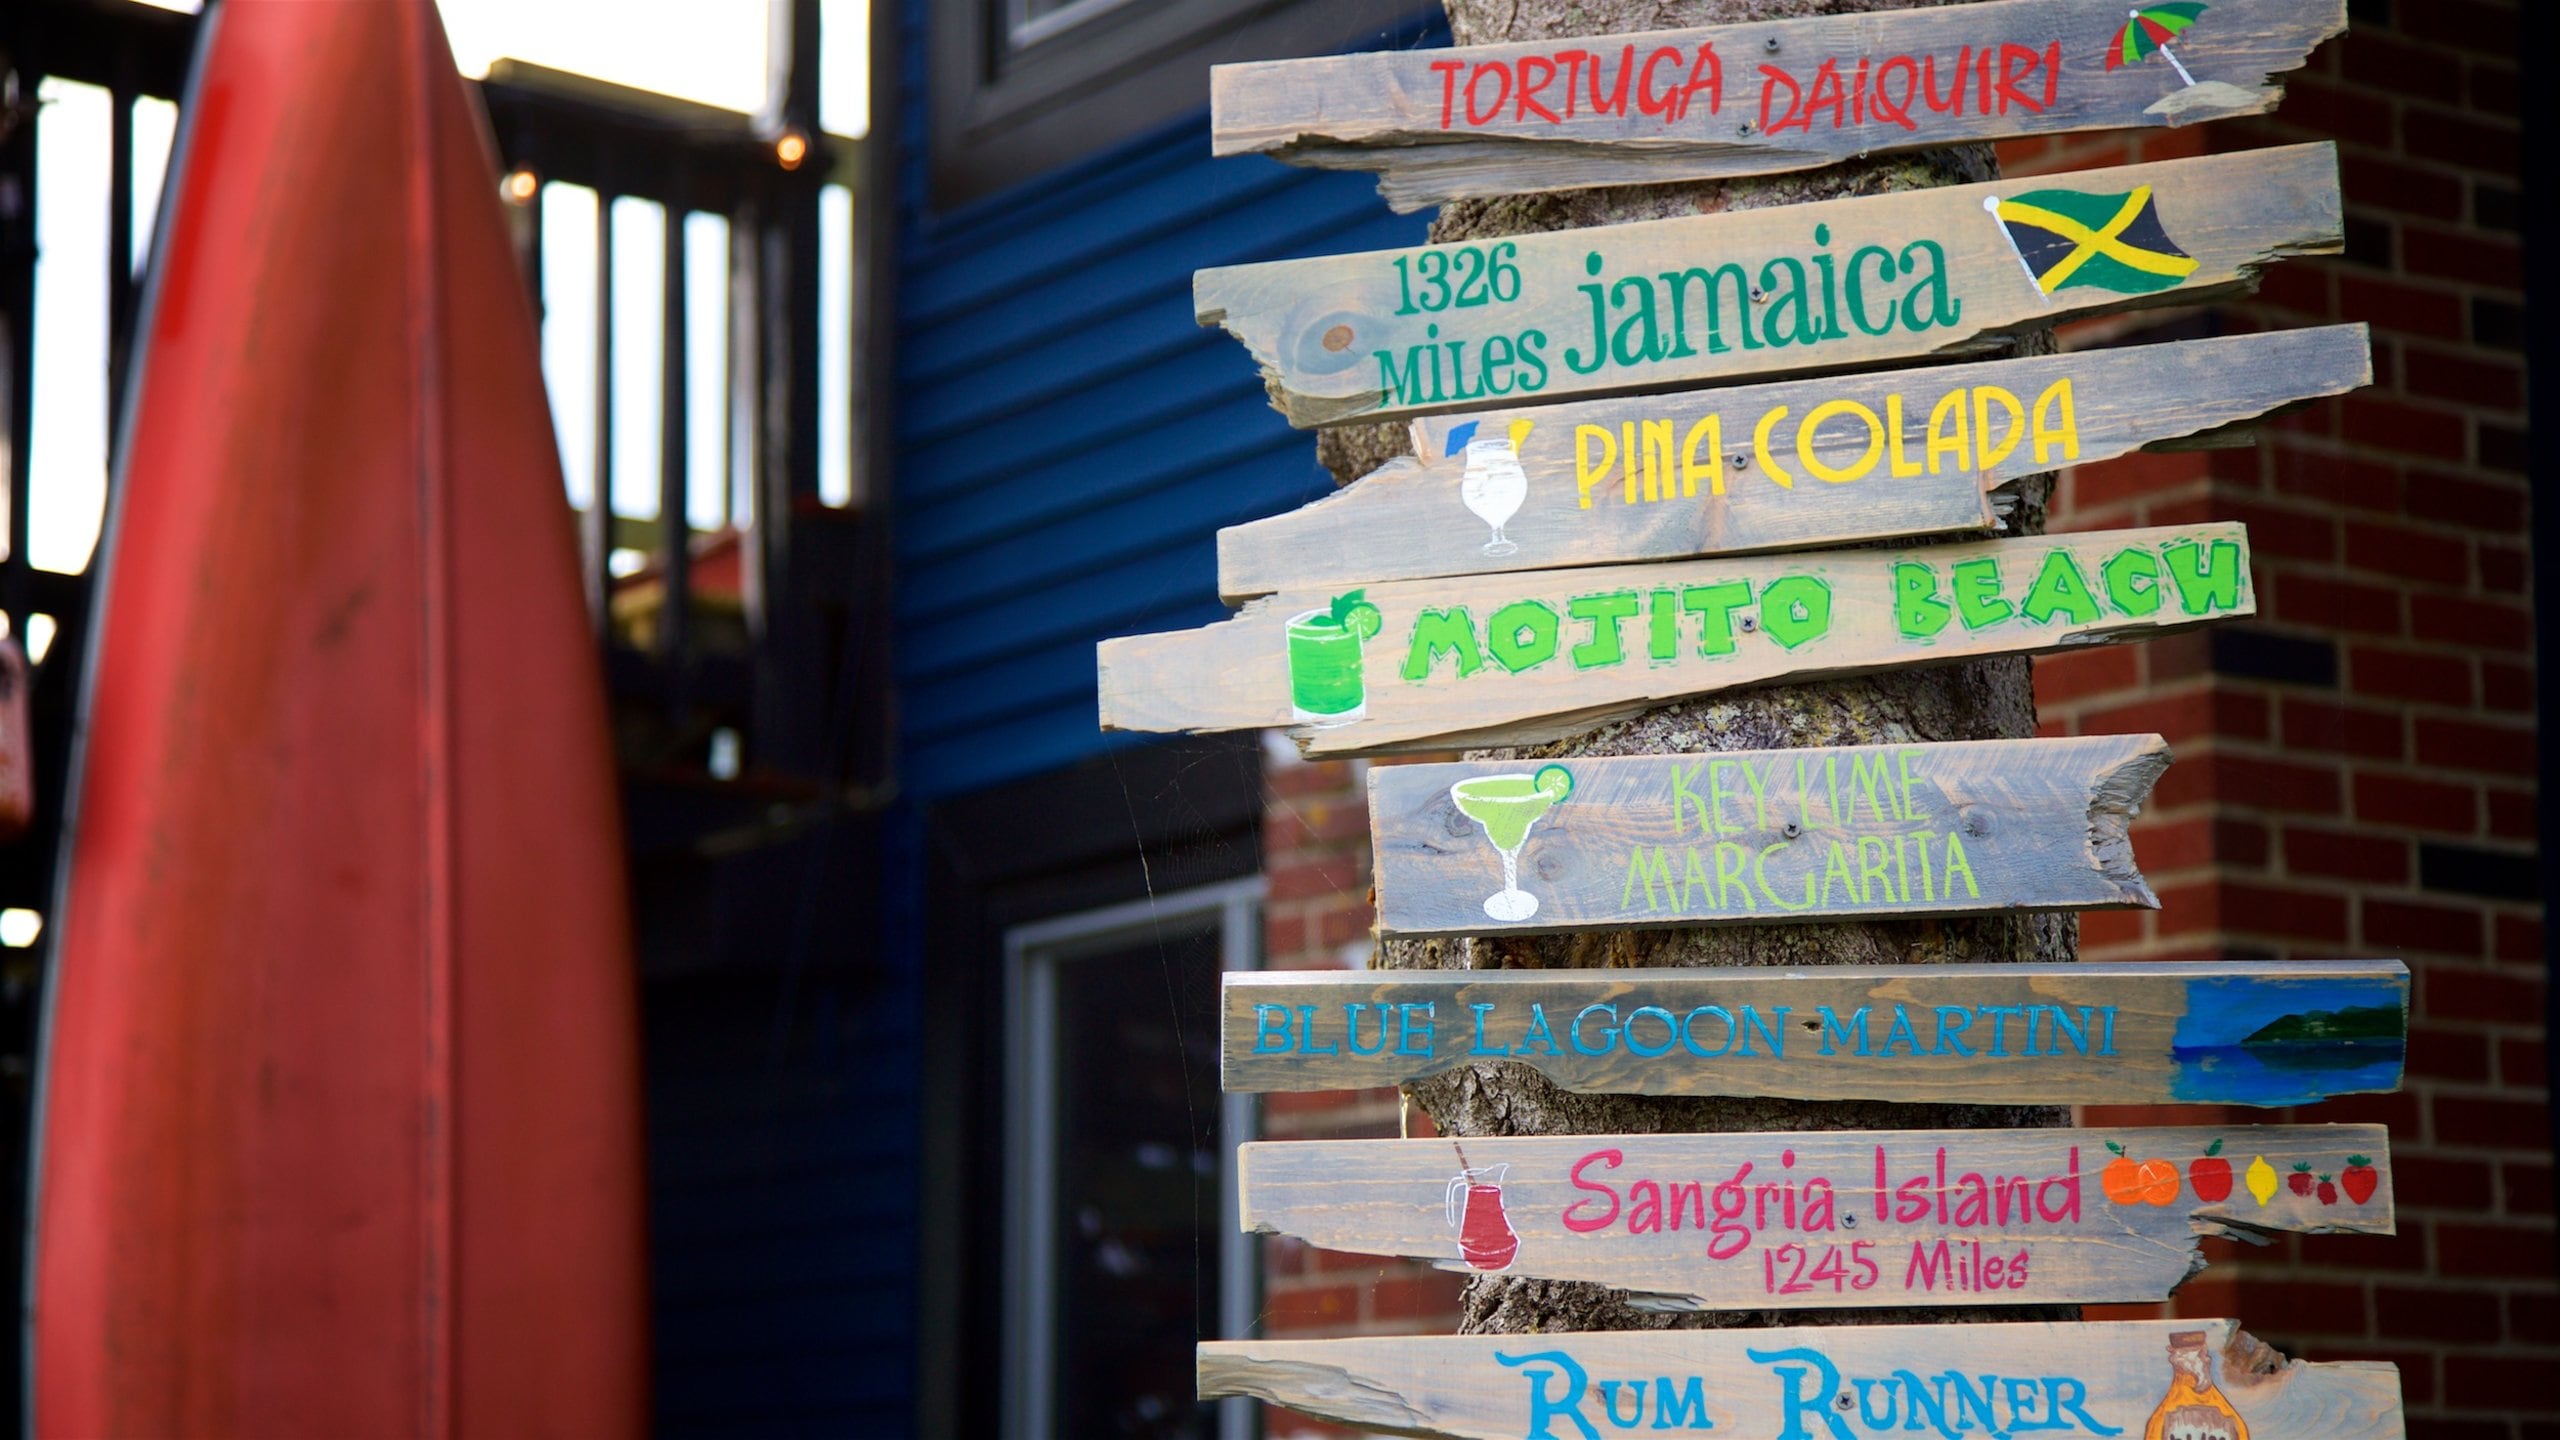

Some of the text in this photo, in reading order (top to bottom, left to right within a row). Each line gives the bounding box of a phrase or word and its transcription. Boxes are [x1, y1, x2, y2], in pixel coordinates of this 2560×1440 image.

[1430, 39, 2061, 136] TORTUGA DAIQUIRI
[1393, 242, 1521, 316] 1326
[1564, 223, 1960, 375] jamaica
[1575, 378, 2079, 509] PINA COLADA
[1402, 536, 2242, 682] MOJITO BEACH
[1671, 749, 1931, 835] KEY LIME
[1620, 831, 1981, 914] MARGARITA
[1252, 1000, 2119, 1060] BLUE LAGOON MARTINI
[1562, 1144, 2081, 1260] Sangria Island
[1764, 1239, 2031, 1295] 1245 Miles
[1494, 1347, 2124, 1440] RUM RUNNER
